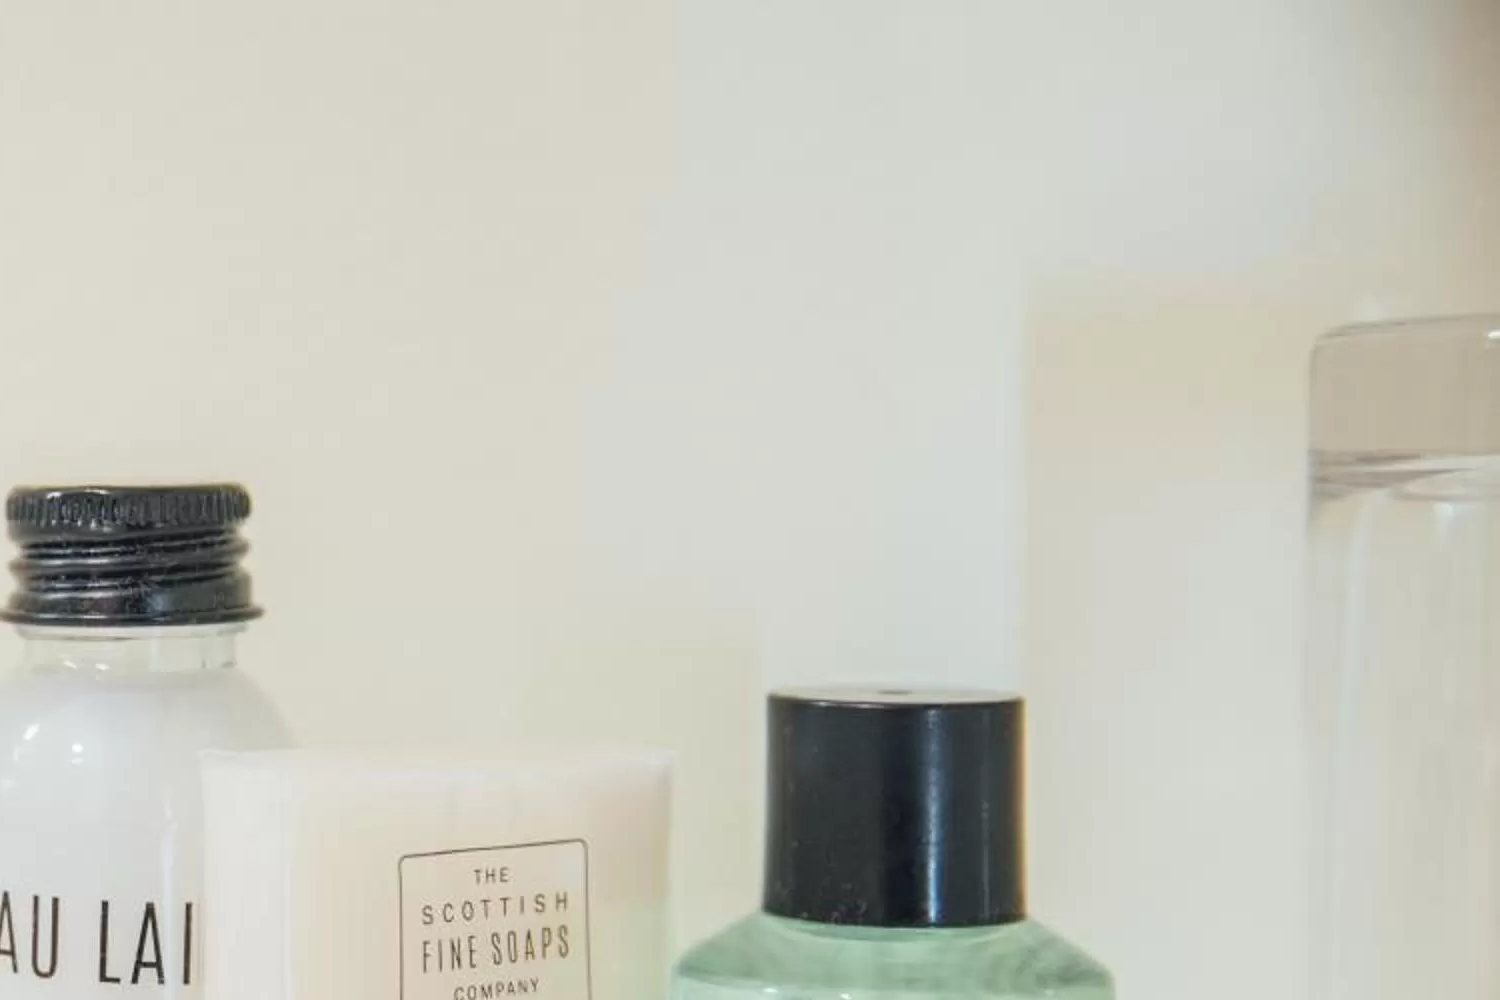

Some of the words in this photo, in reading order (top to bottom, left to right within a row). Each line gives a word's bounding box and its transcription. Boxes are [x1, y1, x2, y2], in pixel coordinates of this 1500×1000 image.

[473, 867, 510, 885] THE
[420, 892, 569, 925] SCOTTISH
[98, 899, 195, 986] LAI
[421, 935, 478, 974] FINE
[491, 925, 570, 966] SOAPS
